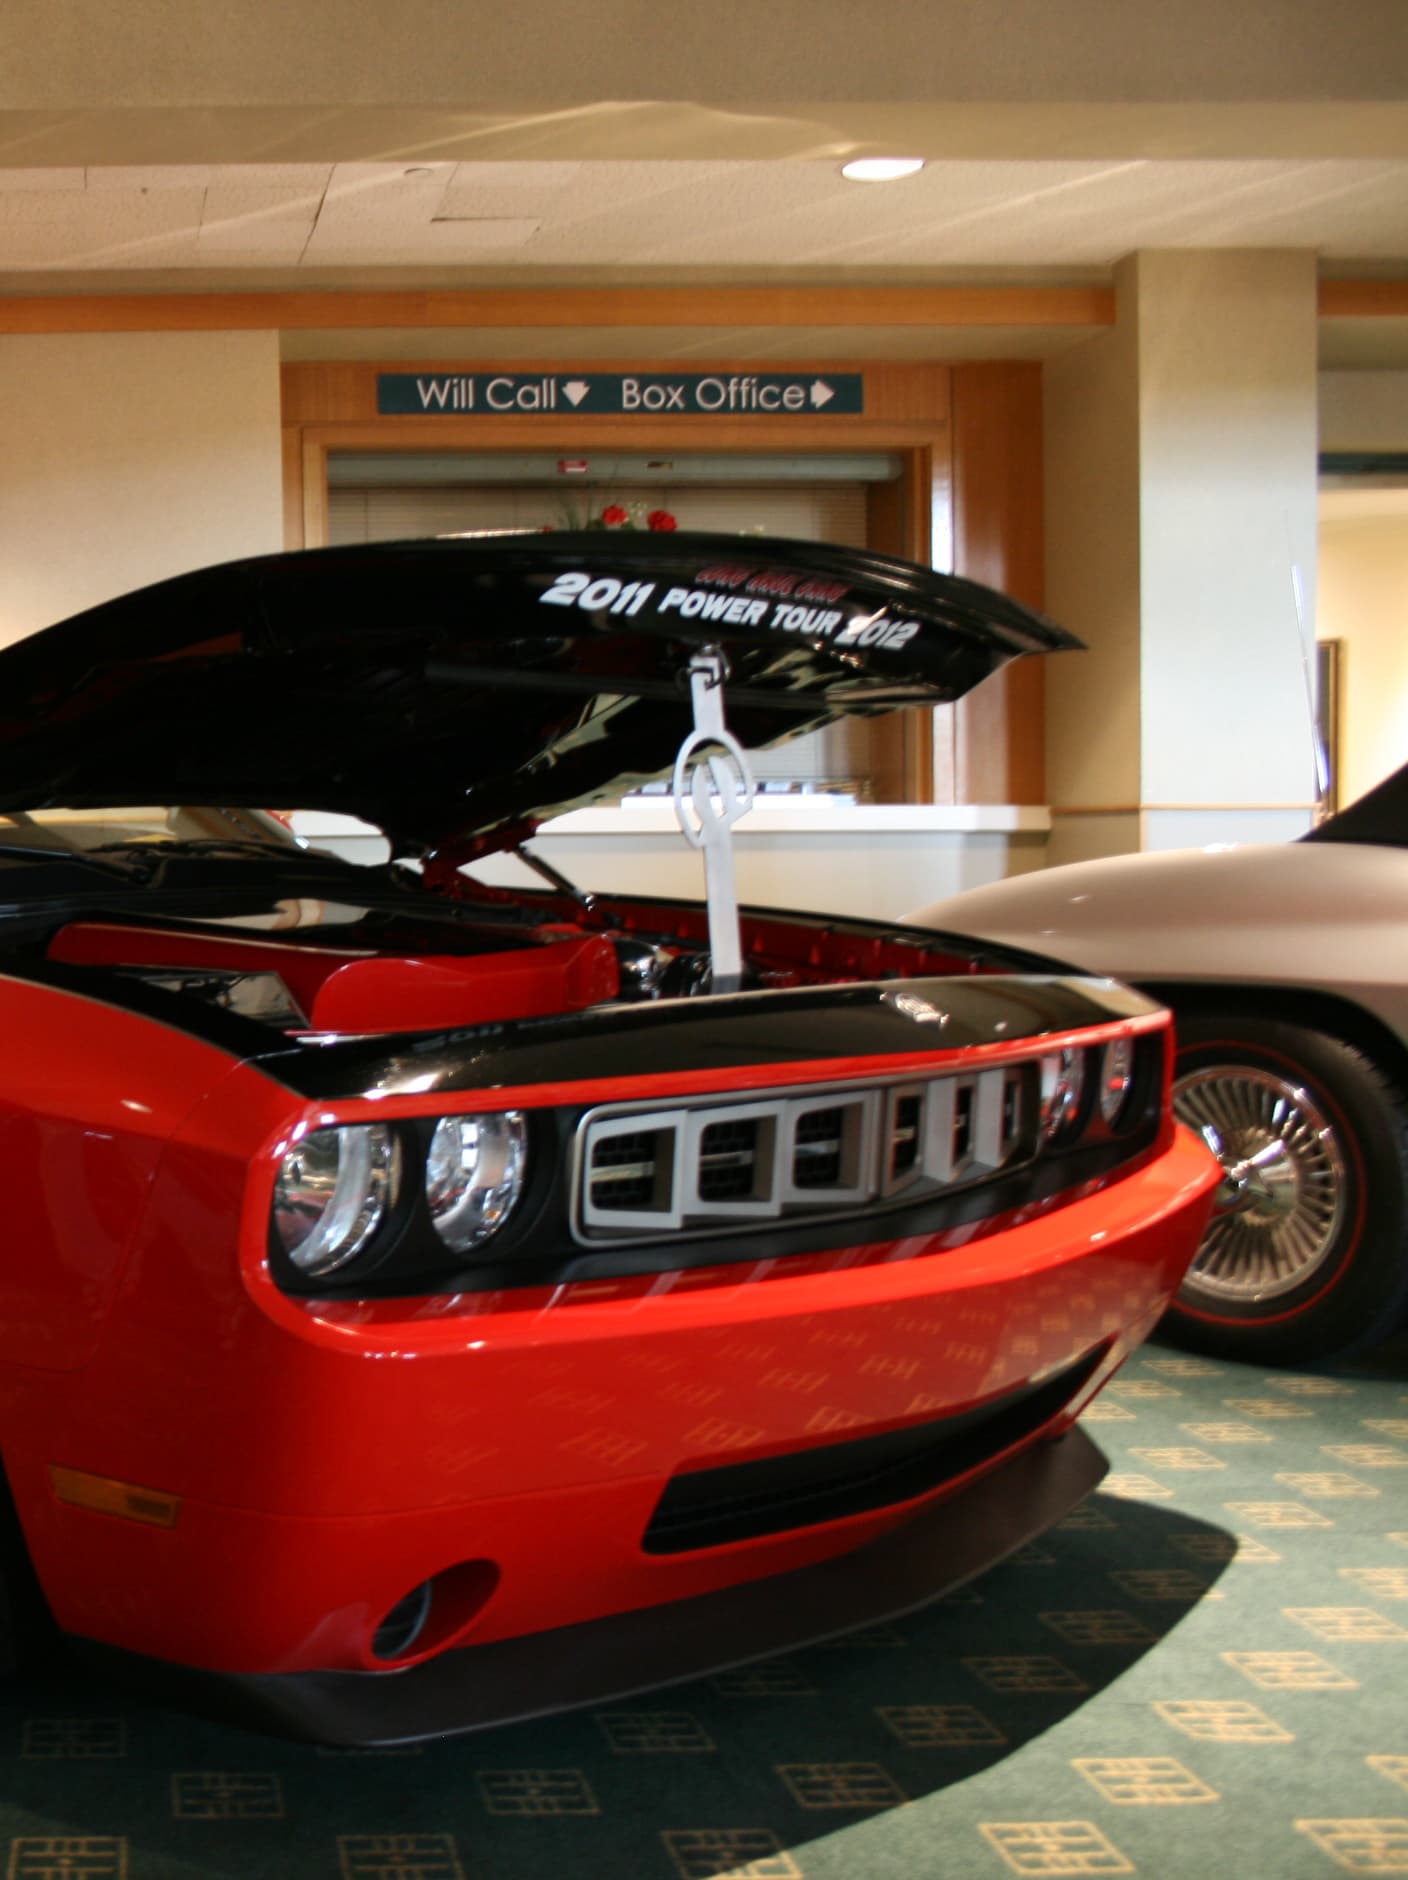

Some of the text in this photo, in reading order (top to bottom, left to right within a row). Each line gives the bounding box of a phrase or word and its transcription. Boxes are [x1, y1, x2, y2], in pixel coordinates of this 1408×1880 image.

[417, 377, 805, 410] Will Call Box Office
[539, 572, 921, 650] 2011 POWER TOUR 2012
